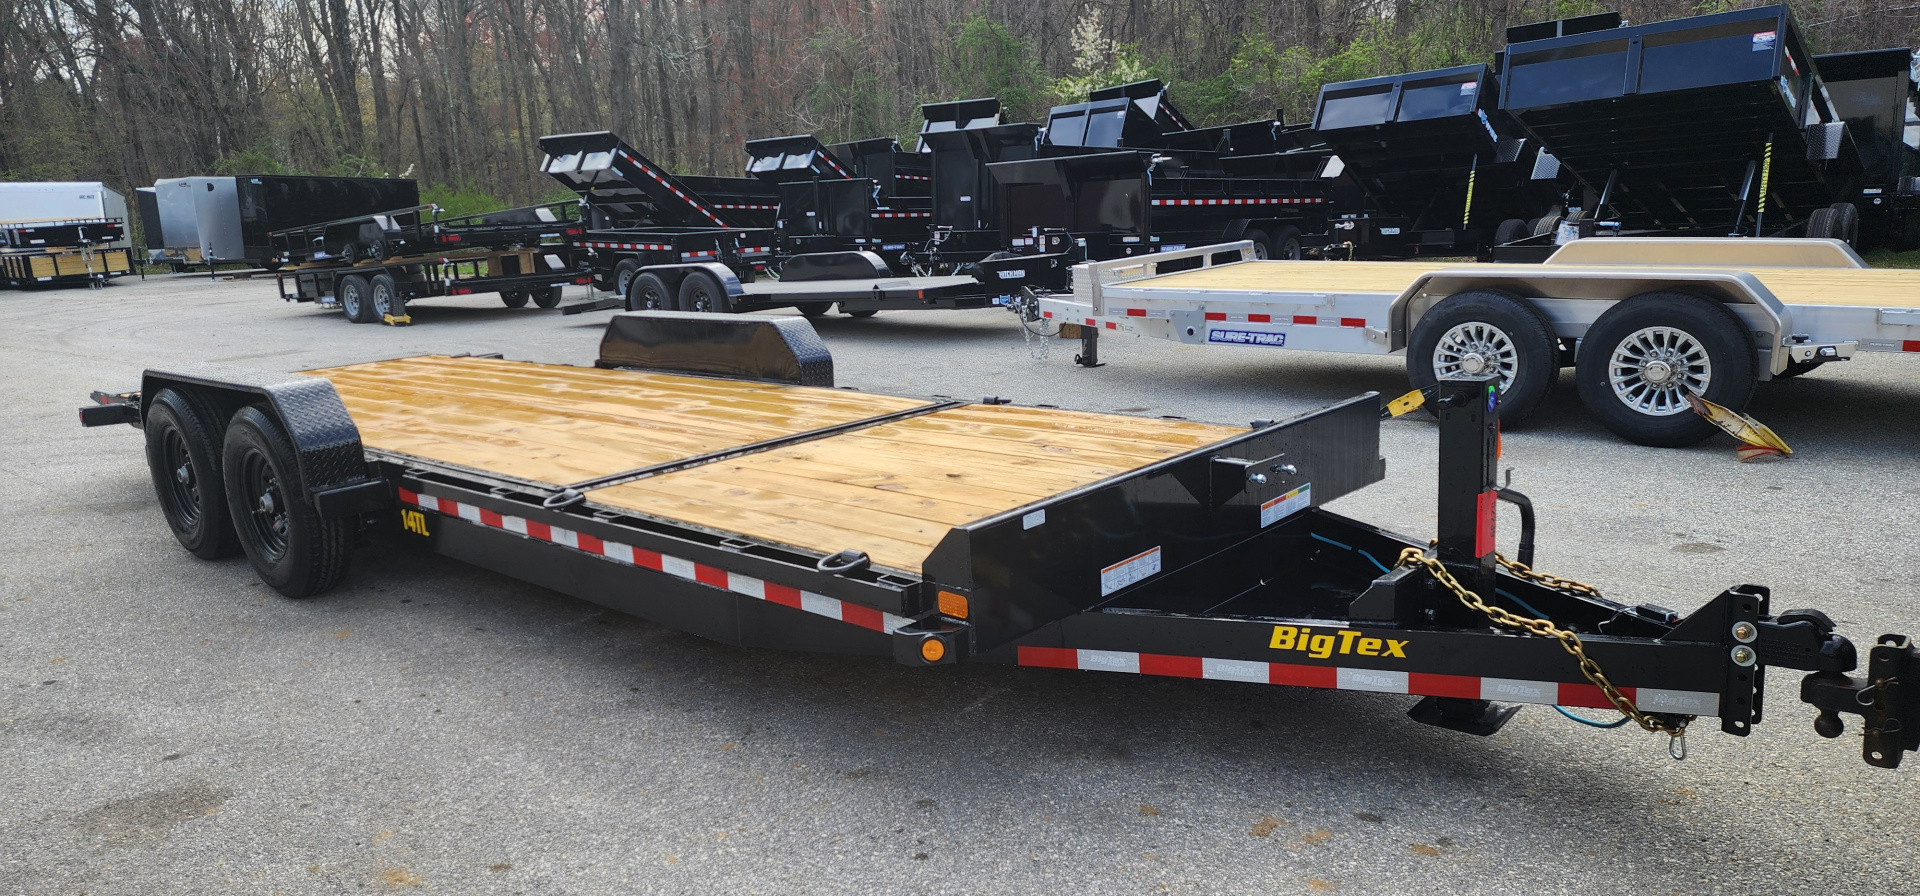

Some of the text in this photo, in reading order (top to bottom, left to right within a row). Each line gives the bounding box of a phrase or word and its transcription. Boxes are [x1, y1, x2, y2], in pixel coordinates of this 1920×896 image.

[1210, 330, 1284, 345] SURE-TRAC
[401, 508, 430, 537] 14TL
[1269, 625, 1410, 659] BigTex
[1090, 655, 1127, 665] BigTex
[1352, 674, 1394, 685] BigTex
[1496, 684, 1541, 696] BigTex
[1652, 693, 1702, 706] BigTex
